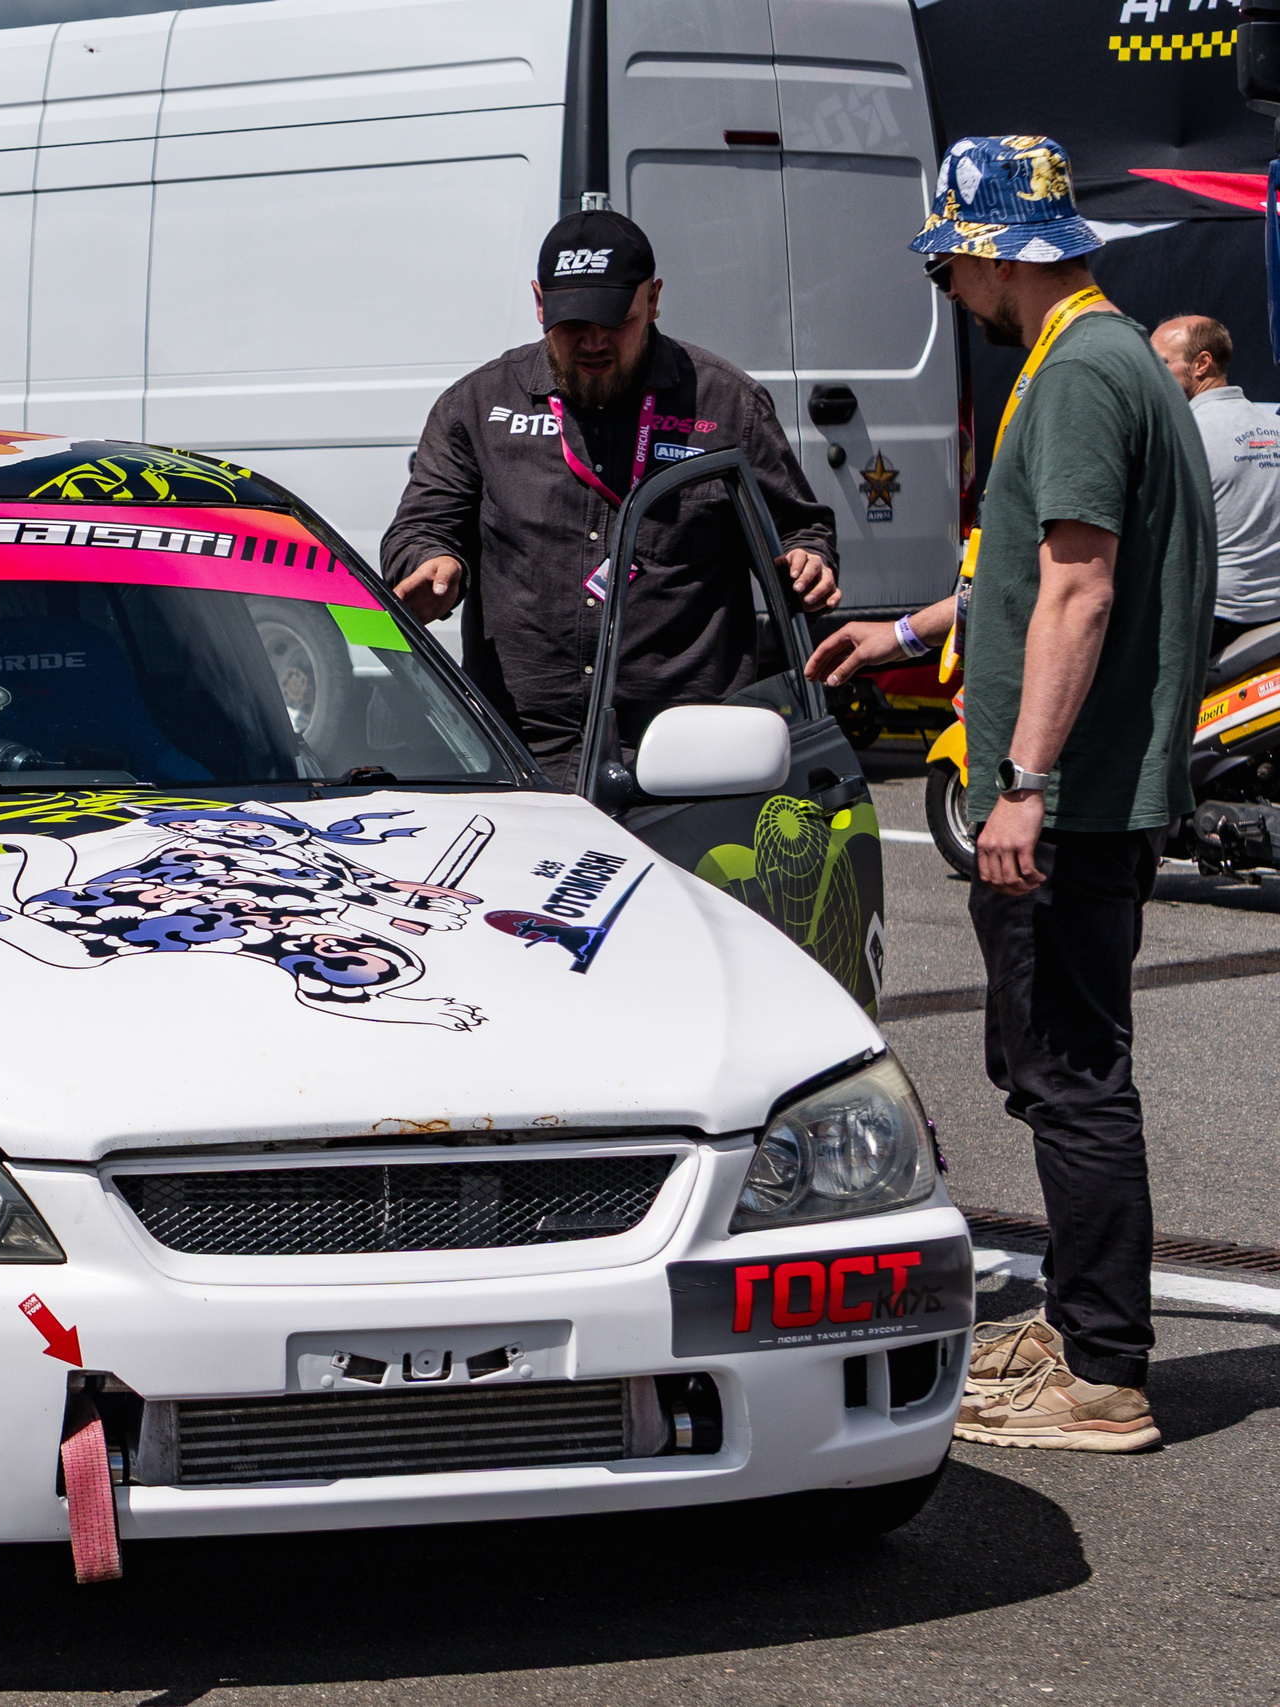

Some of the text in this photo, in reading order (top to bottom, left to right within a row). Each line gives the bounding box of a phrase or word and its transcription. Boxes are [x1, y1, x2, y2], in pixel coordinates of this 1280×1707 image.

[555, 249, 614, 271] RDS
[510, 413, 560, 436] ВТБ
[695, 420, 717, 433] GP
[636, 424, 650, 462] OFFICIAL
[1234, 430, 1255, 446] Race
[657, 447, 705, 459] AIMO
[541, 850, 629, 918] OTOMOSHI
[732, 1251, 922, 1333] ГОСТ
[25, 1301, 42, 1316] TOW
[776, 1325, 903, 1344] ЛЮБИМ ТАЧКИ ПО РУССКИ
